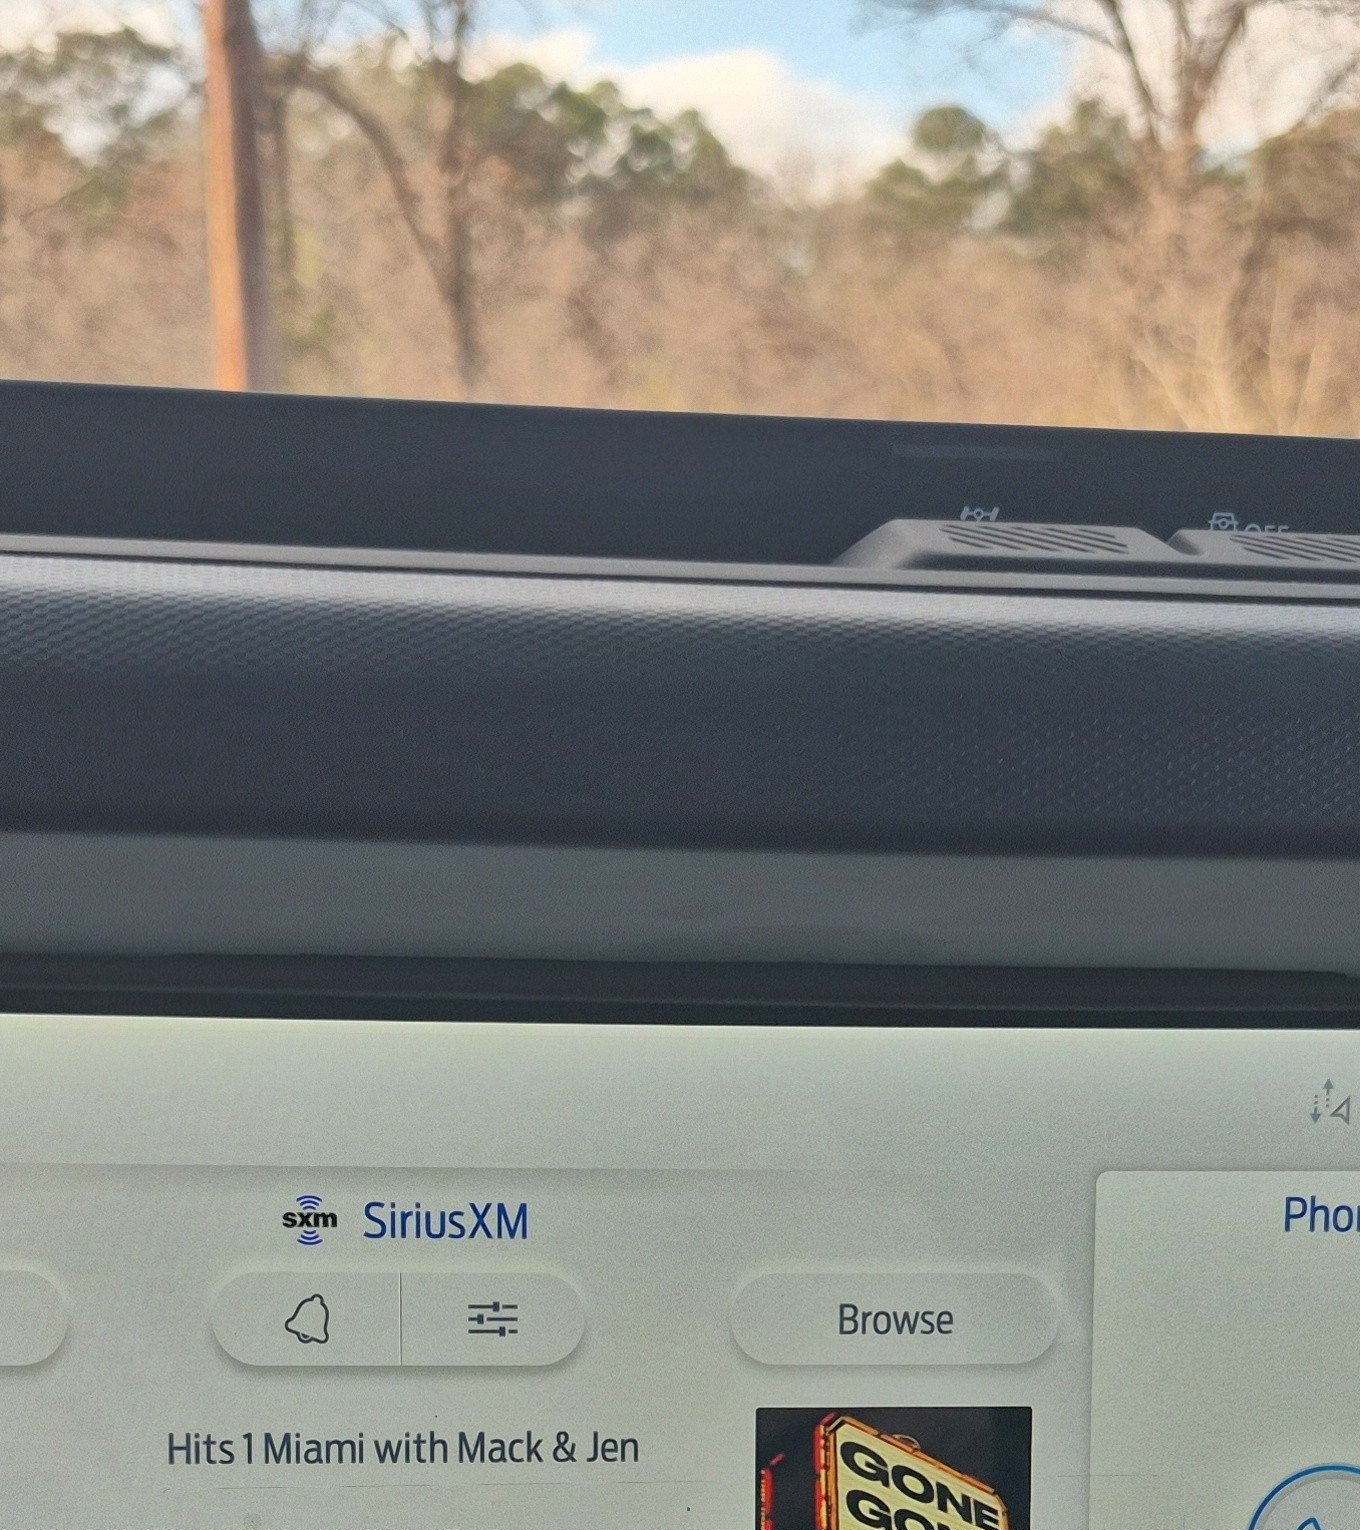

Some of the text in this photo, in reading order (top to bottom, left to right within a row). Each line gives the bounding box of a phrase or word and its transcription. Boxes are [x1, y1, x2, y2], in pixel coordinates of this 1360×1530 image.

[281, 1201, 528, 1240] sxm SiriusXM
[838, 1303, 954, 1336] Browse
[168, 1430, 639, 1465] Hits 1 Miami with Mack & Jen
